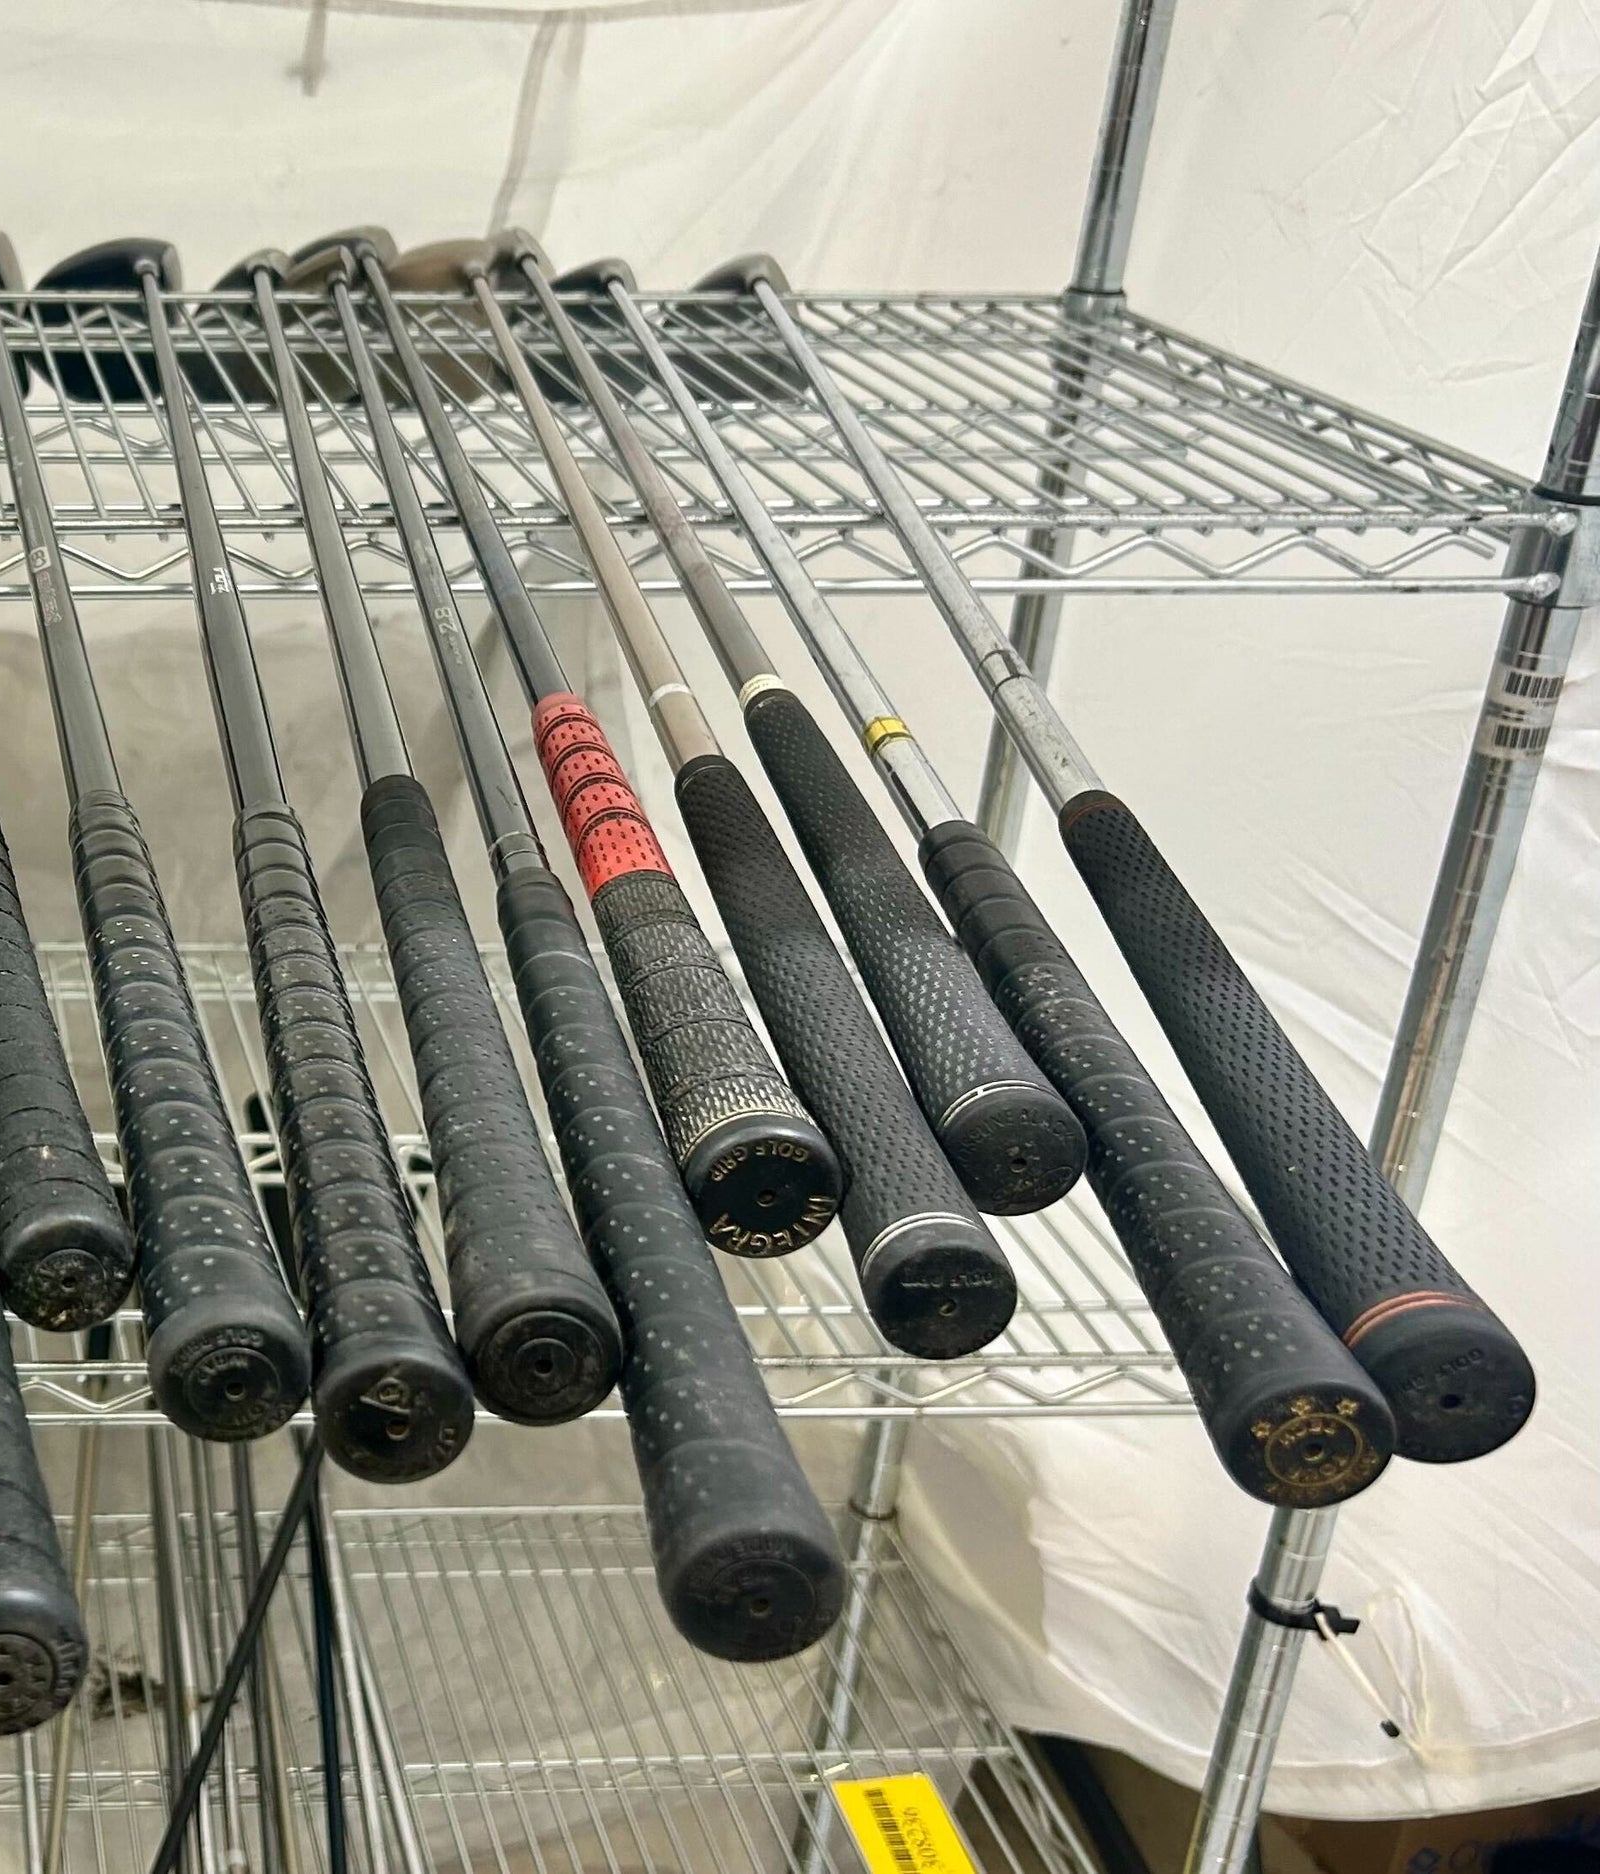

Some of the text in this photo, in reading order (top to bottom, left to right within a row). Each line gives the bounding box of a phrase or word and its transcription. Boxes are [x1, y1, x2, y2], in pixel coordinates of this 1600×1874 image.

[710, 1140, 810, 1183] GOLF GRIP
[710, 1195, 838, 1255] INTEGRA
